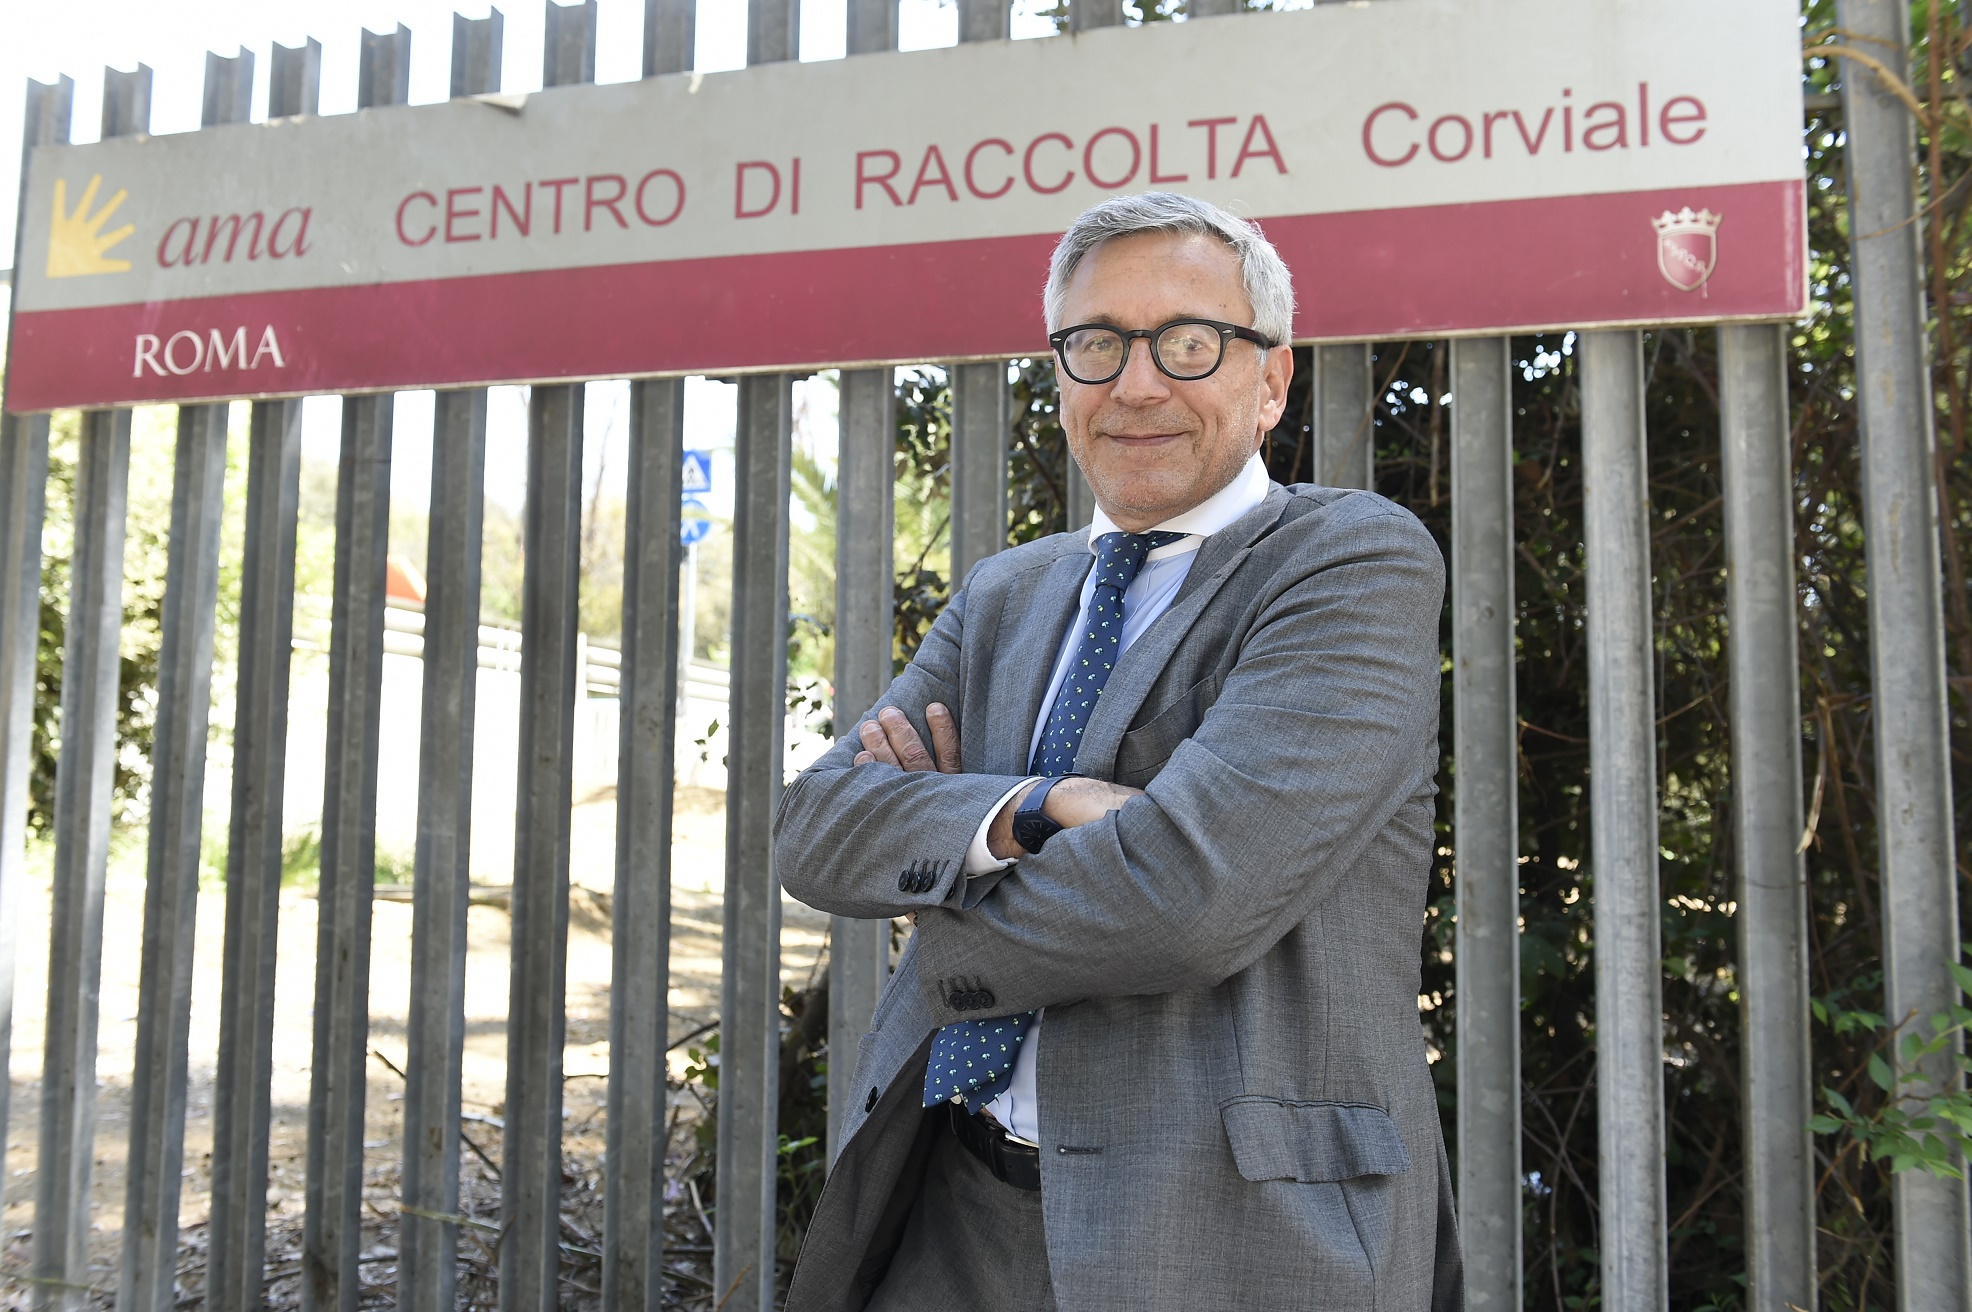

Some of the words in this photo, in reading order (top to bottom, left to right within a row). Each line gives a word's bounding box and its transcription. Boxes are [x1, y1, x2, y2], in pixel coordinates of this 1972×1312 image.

[395, 168, 686, 248] CENTRO
[734, 157, 800, 219] DI
[854, 113, 1289, 210] RACCOLTA
[1362, 81, 1708, 167] Corviale
[156, 205, 313, 268] ama
[132, 324, 286, 378] ROMA
